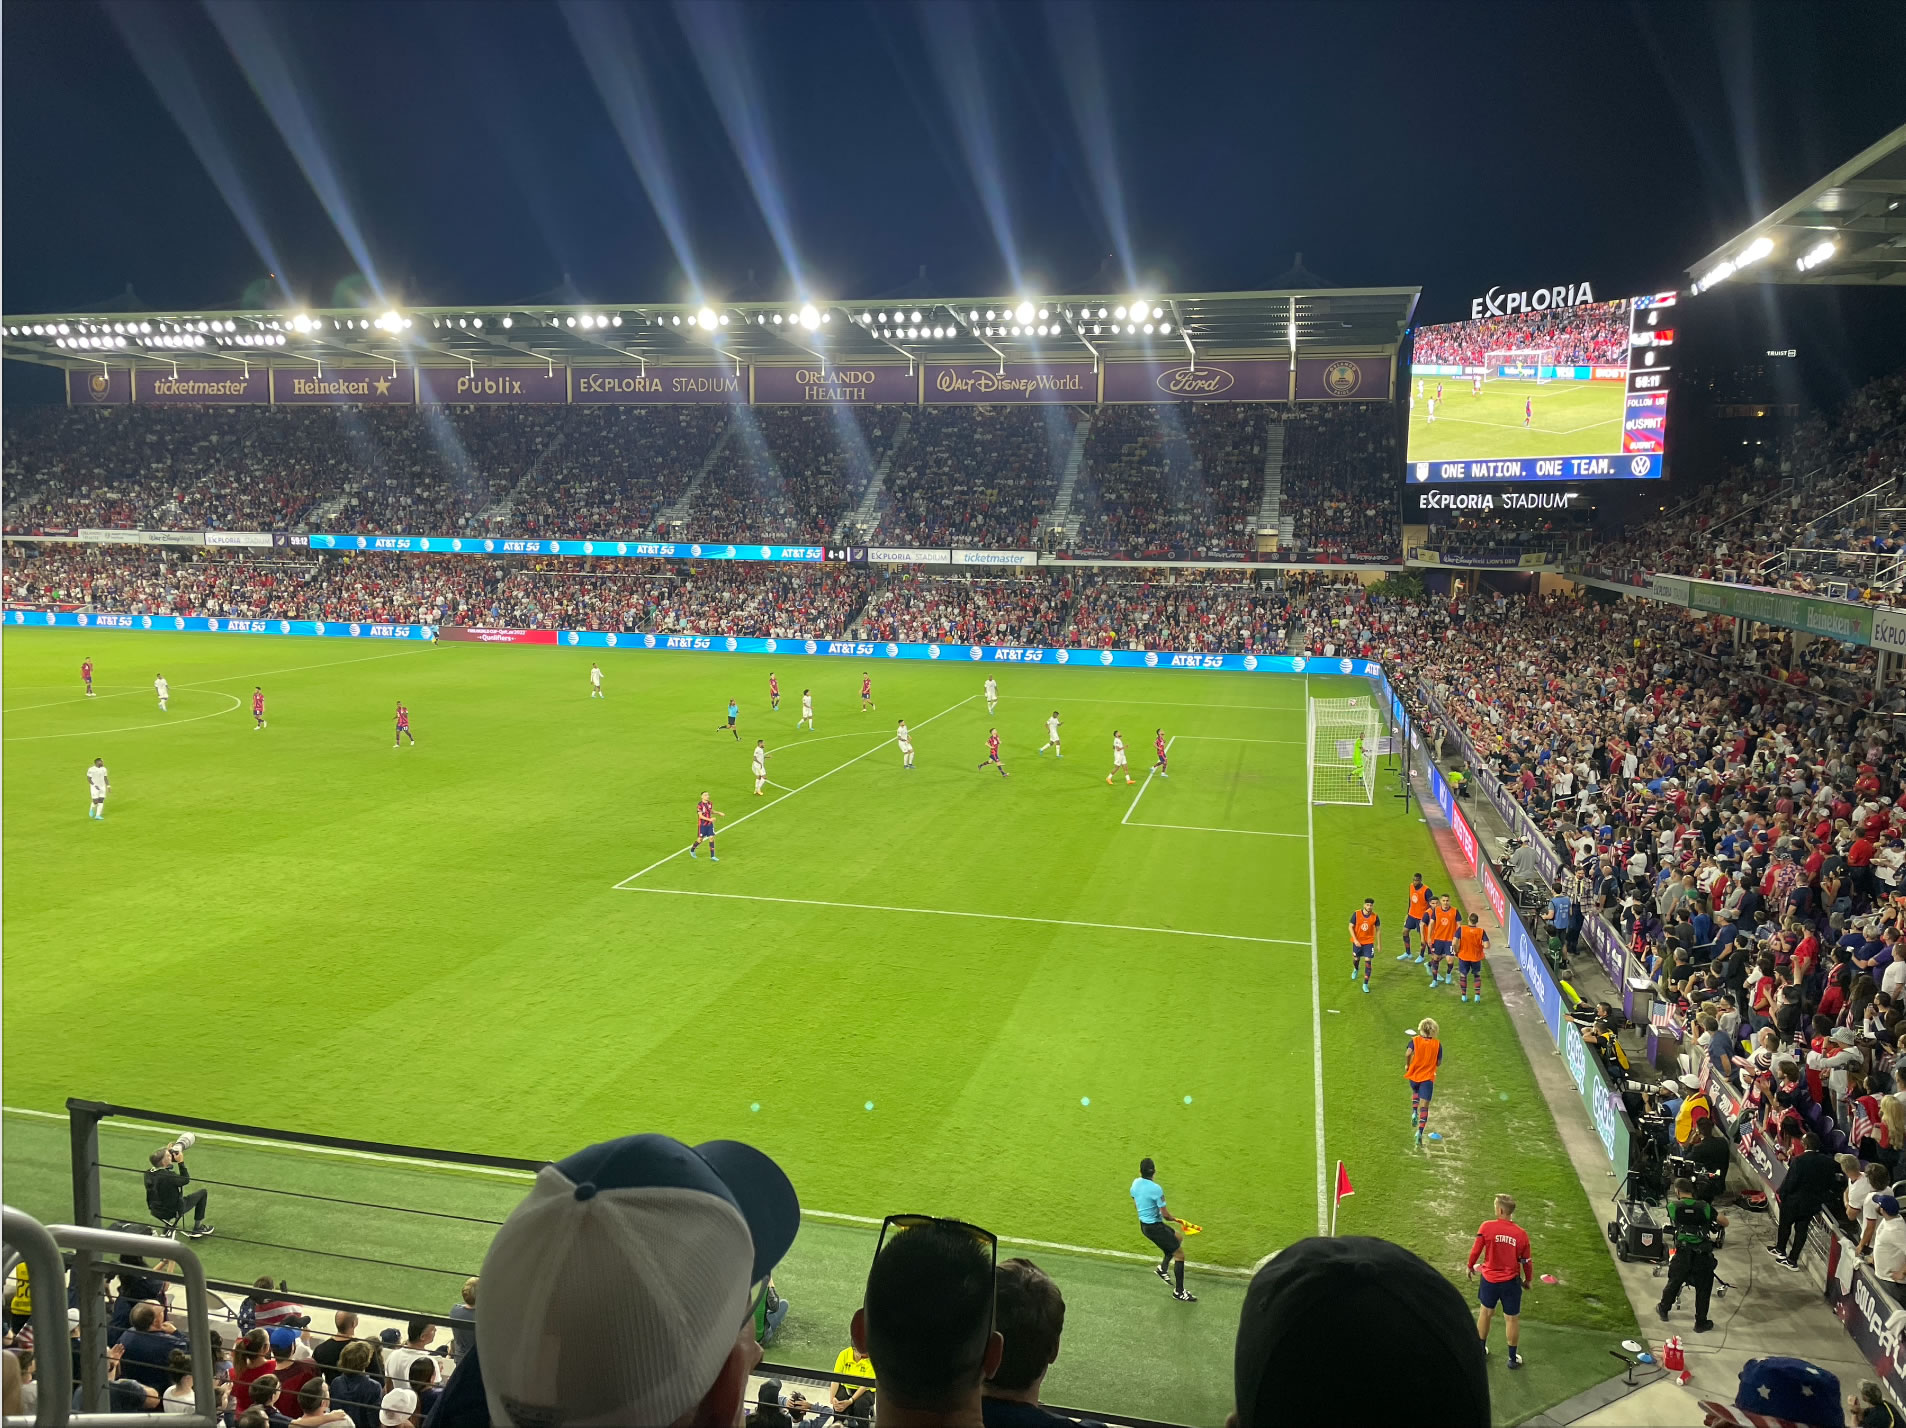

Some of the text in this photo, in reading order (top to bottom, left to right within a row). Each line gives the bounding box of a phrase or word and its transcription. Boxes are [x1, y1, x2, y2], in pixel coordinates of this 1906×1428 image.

[1471, 281, 1594, 319] EXPLORIA
[1647, 311, 1657, 326] 4
[580, 373, 739, 393] EXPLORIA STADIUM
[795, 369, 876, 385] ORLANDO
[1170, 369, 1220, 392] Ford
[154, 376, 248, 396] ticketmaster
[293, 376, 370, 395] Heineken
[457, 376, 522, 395] Publix
[804, 385, 866, 401] HEALTH
[1627, 398, 1653, 407] FOLLOW
[1441, 458, 1615, 478] ONE NATION. ONE TEAM.
[1420, 490, 1569, 509] EXPLORIA STADIUM
[290, 536, 308, 545] 59:12
[375, 539, 411, 549] AT&T 5G
[503, 542, 541, 552] AT&T 5G
[637, 545, 675, 555] AT&T 5G
[781, 549, 821, 559] AT&T 5G
[828, 549, 845, 560] 4-0
[871, 550, 948, 562] EXPLORIA STADIUM
[963, 553, 1025, 565] ticketmaster
[96, 616, 132, 627] AT&T 5G
[228, 621, 266, 632] AT&T 5G
[1806, 606, 1850, 636] Heineken
[370, 626, 410, 637] AT&T 5G
[481, 634, 512, 642] Qualifiers
[667, 637, 711, 649] AT&T 5G
[828, 643, 874, 655] AT&T 5G
[994, 649, 1043, 661] AT&T 5G
[1171, 656, 1223, 668] AT&T 5G
[1364, 662, 1380, 676] AT&T
[1484, 871, 1505, 918] CHIPOTLE
[1527, 952, 1545, 1003] Allstate
[1495, 1234, 1517, 1247] STATES
[1855, 1279, 1876, 1322] SOLO
